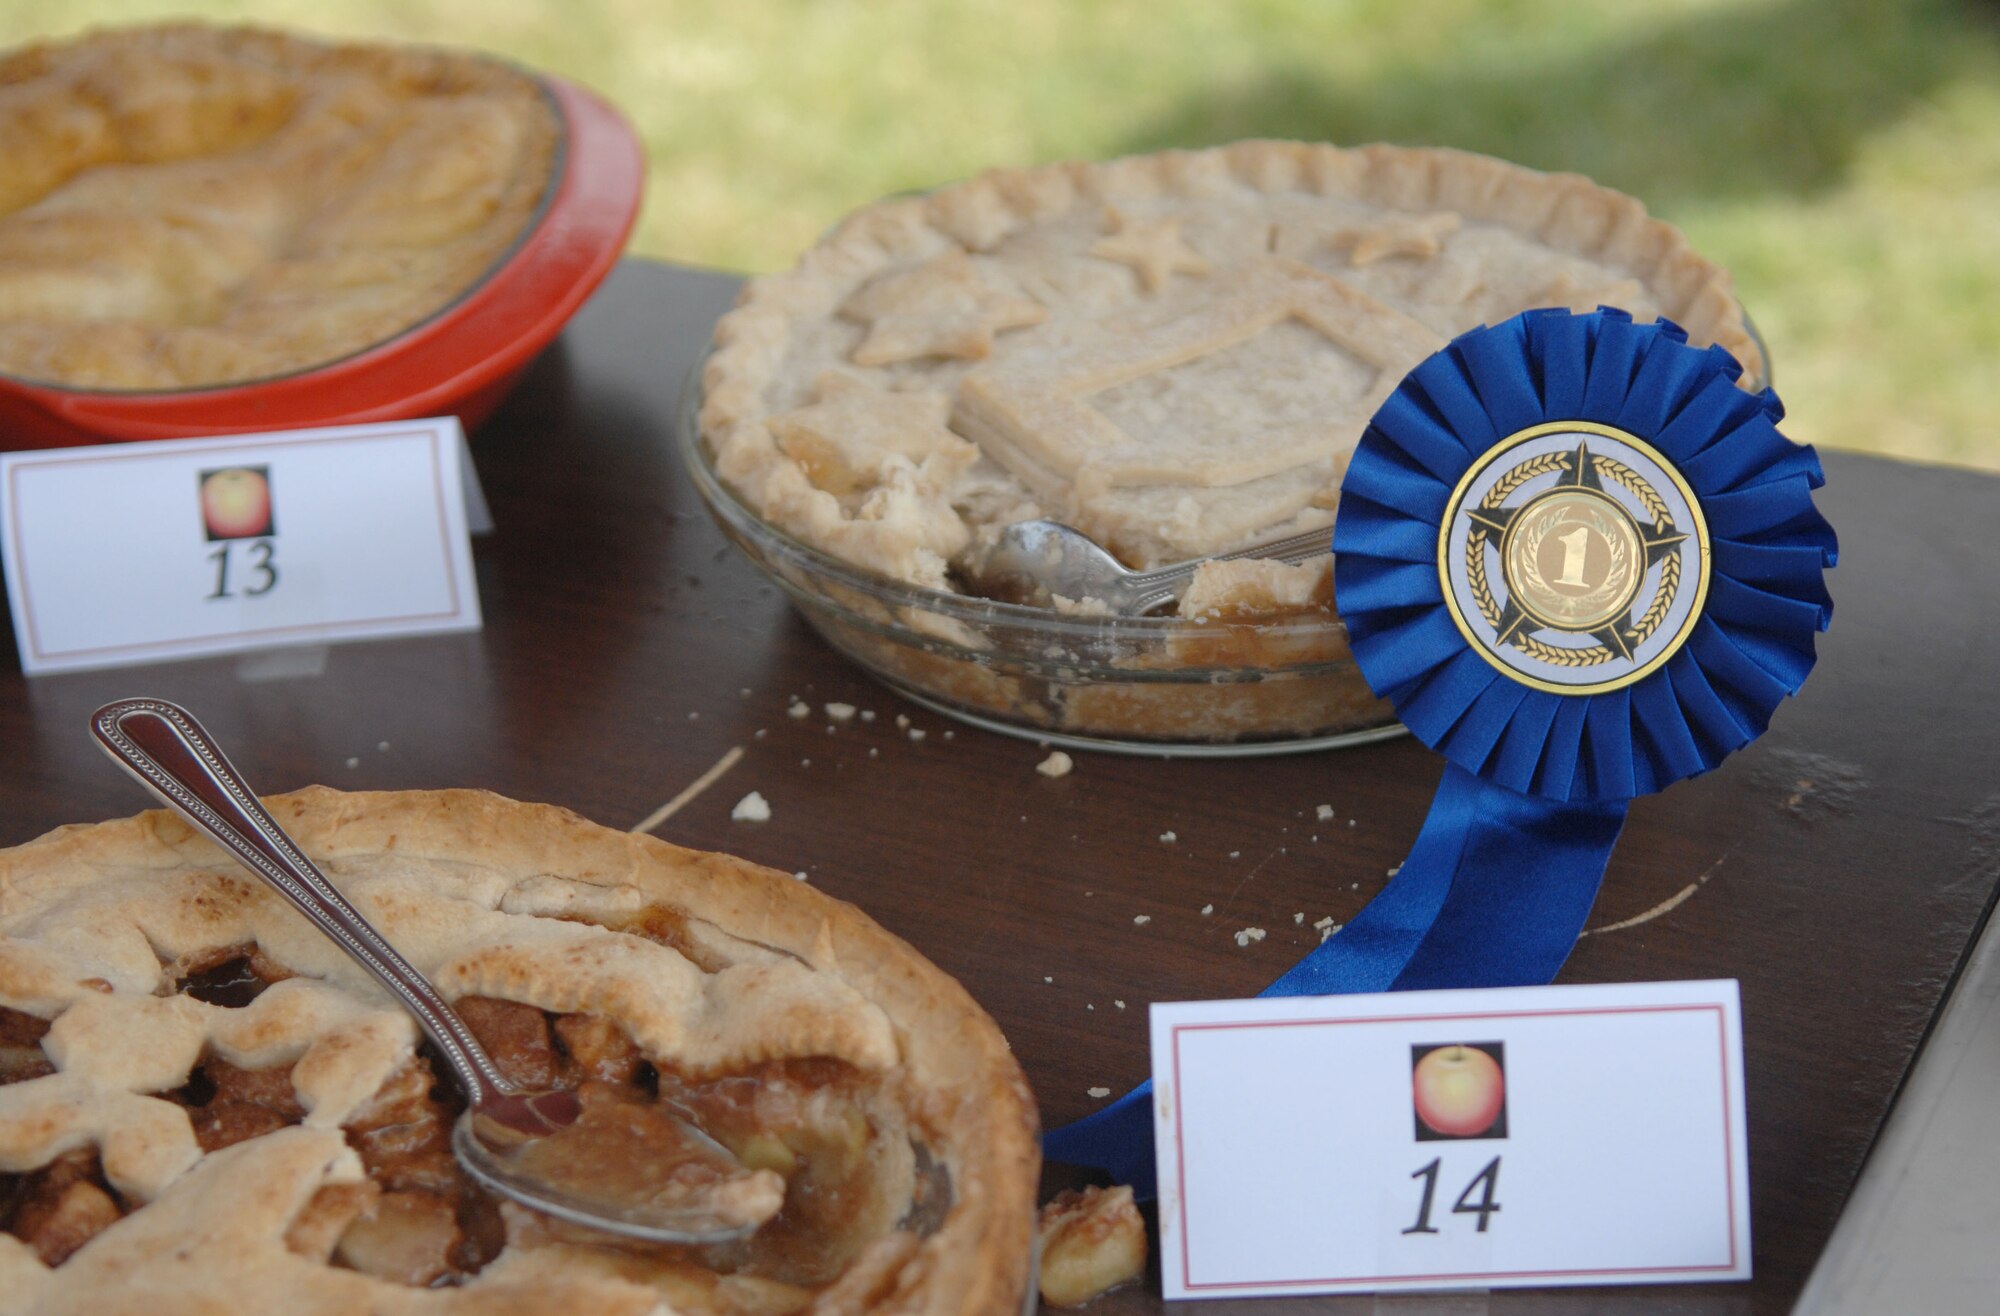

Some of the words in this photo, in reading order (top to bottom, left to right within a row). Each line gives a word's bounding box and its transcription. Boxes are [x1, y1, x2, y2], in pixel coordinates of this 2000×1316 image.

[204, 540, 278, 599] 13
[1553, 527, 1590, 588] 1
[1401, 1156, 1501, 1234] 14
